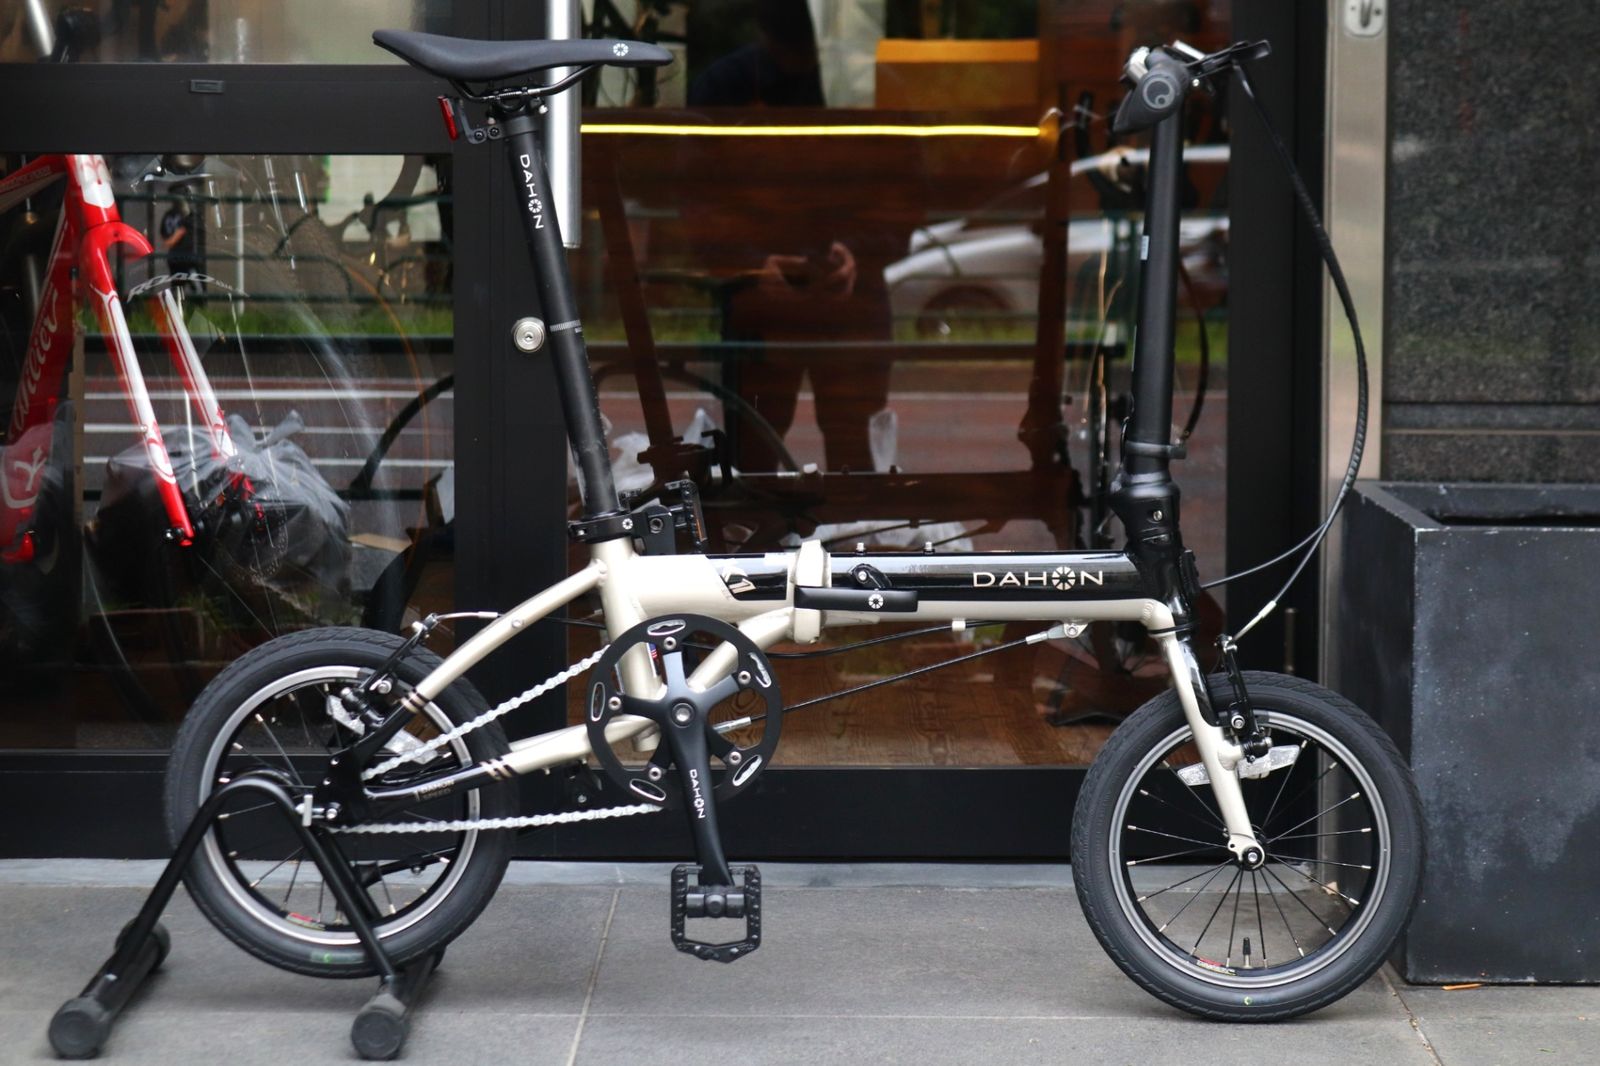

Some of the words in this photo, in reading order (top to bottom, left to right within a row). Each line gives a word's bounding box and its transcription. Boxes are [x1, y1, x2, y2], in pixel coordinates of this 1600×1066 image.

[520, 153, 544, 229] DAHON
[972, 566, 1103, 591] DAHON
[689, 768, 706, 819] DAHON
